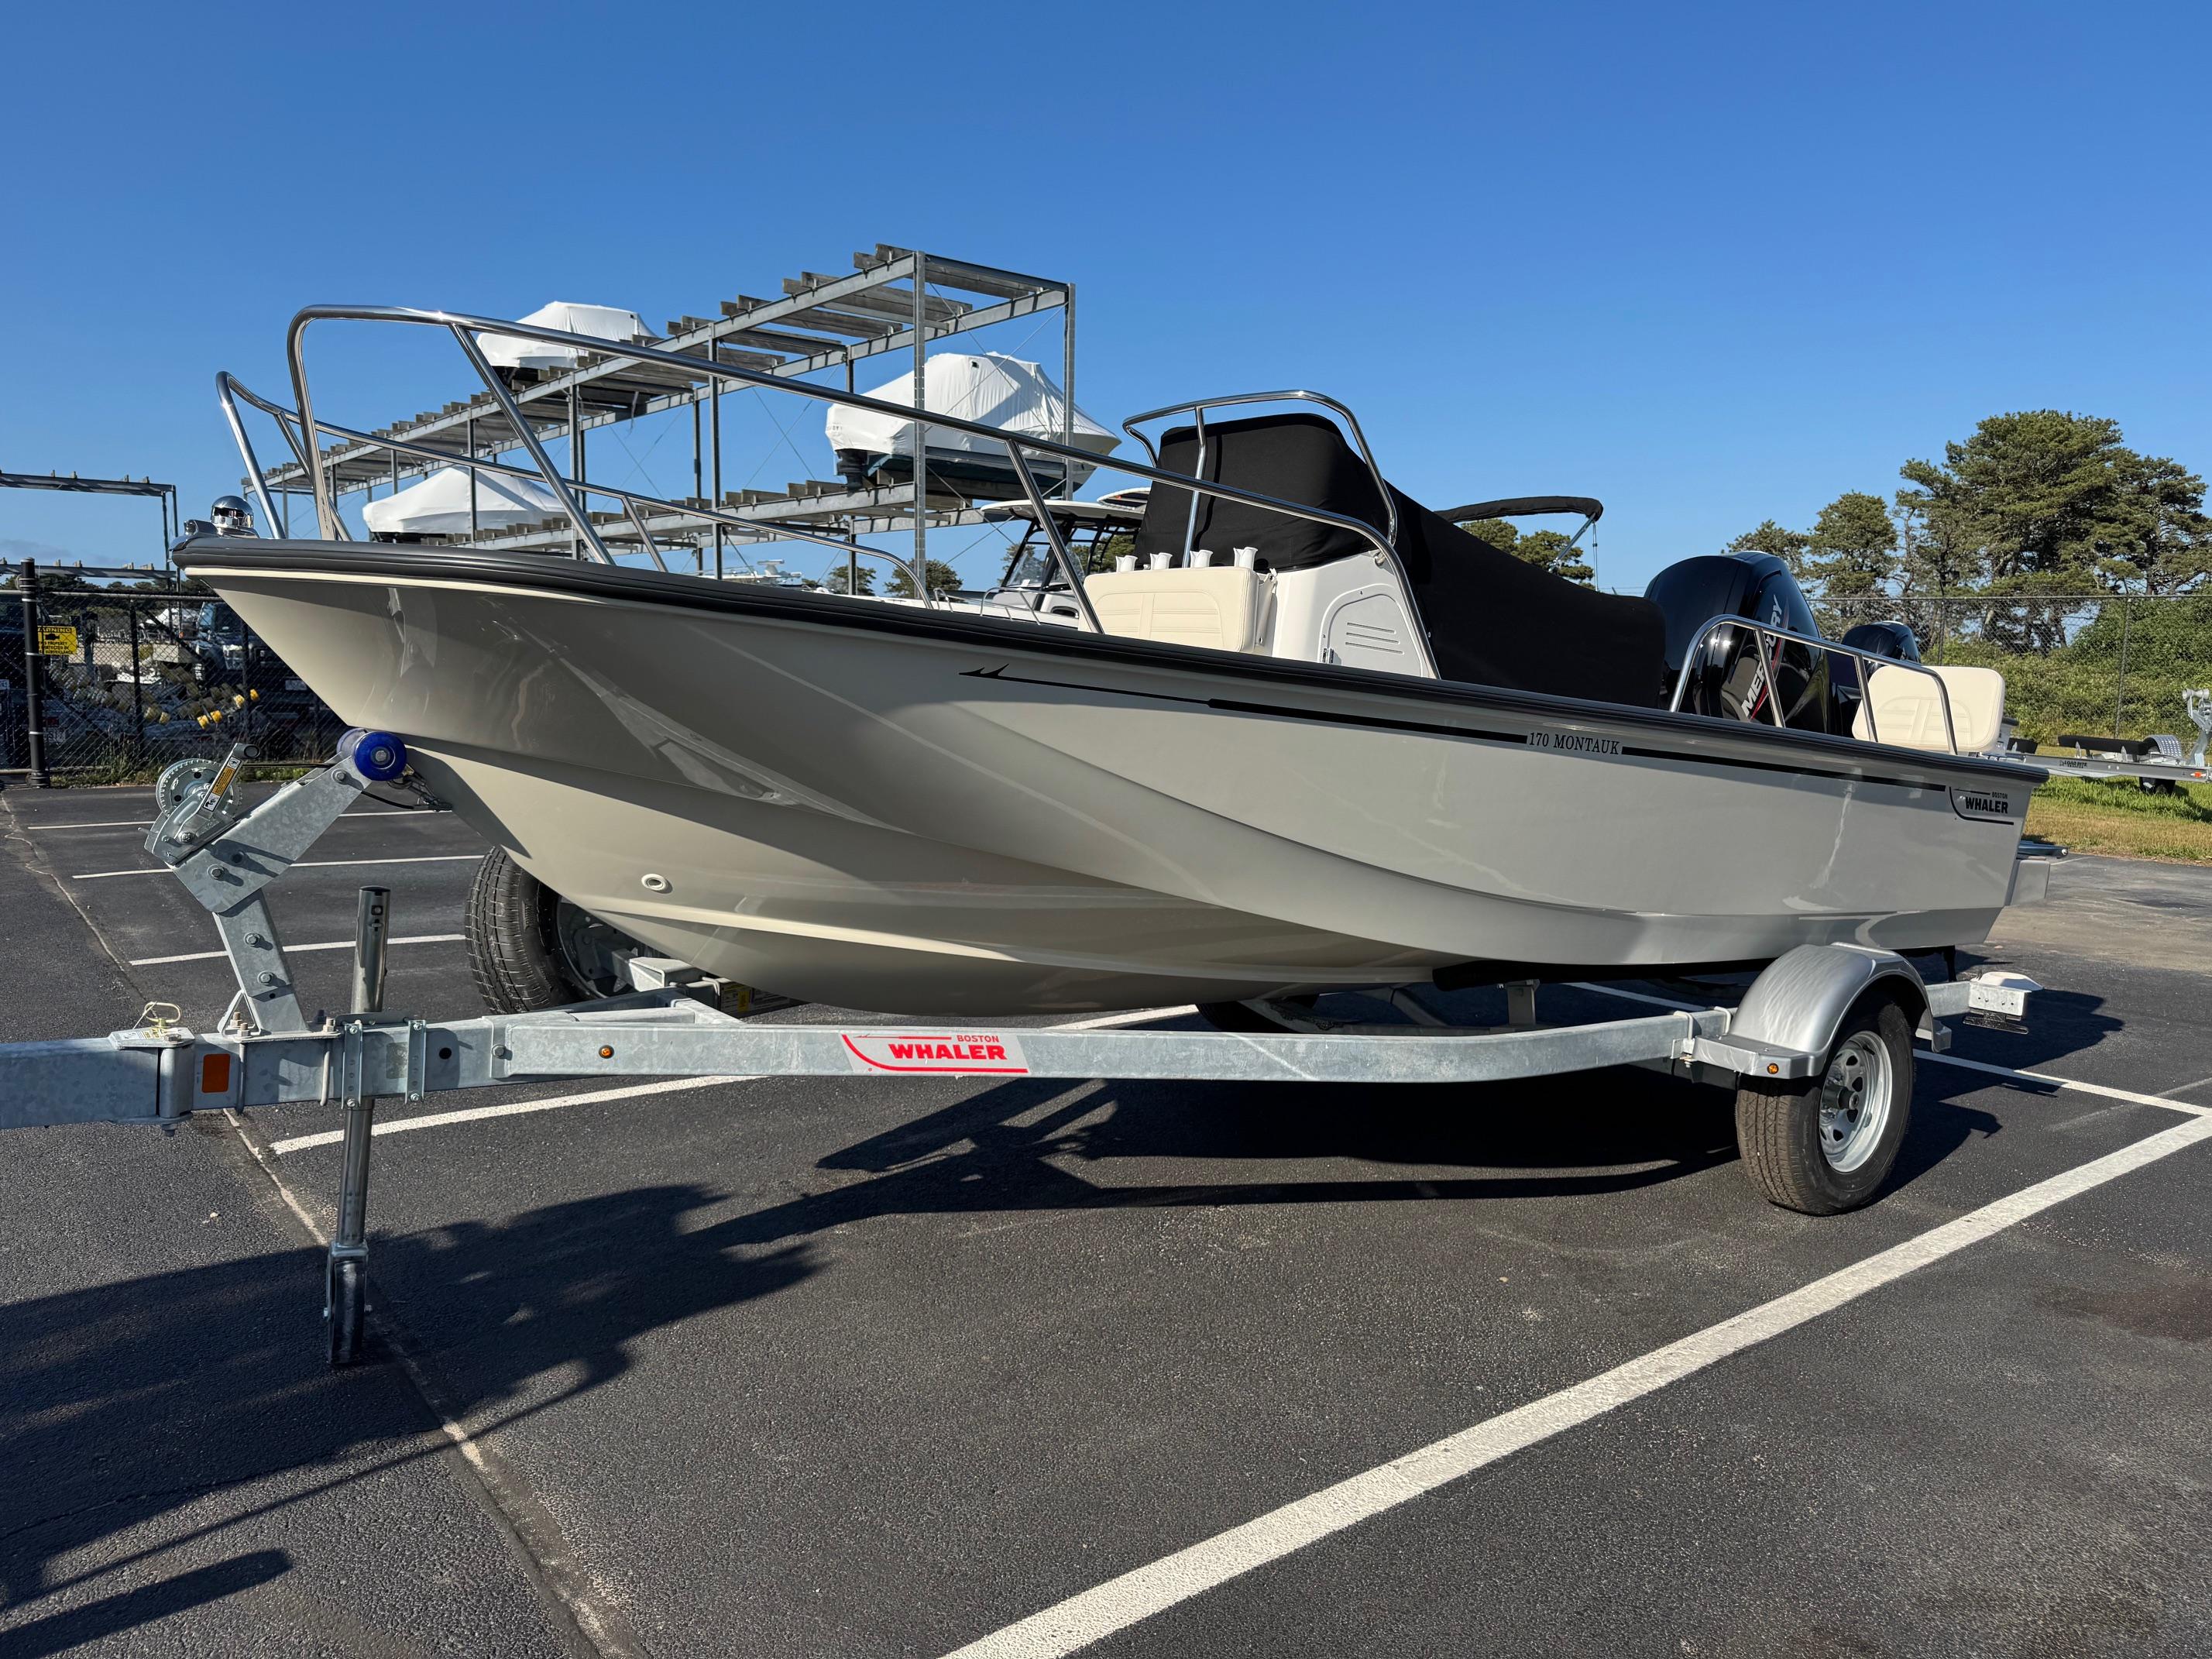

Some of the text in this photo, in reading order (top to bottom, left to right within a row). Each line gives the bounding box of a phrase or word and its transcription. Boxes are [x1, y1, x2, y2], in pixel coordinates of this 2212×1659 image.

[1529, 732, 1620, 754] 170 MONTAUK
[1965, 796, 2008, 814] WHALER
[888, 1044, 1008, 1060] WHALER
